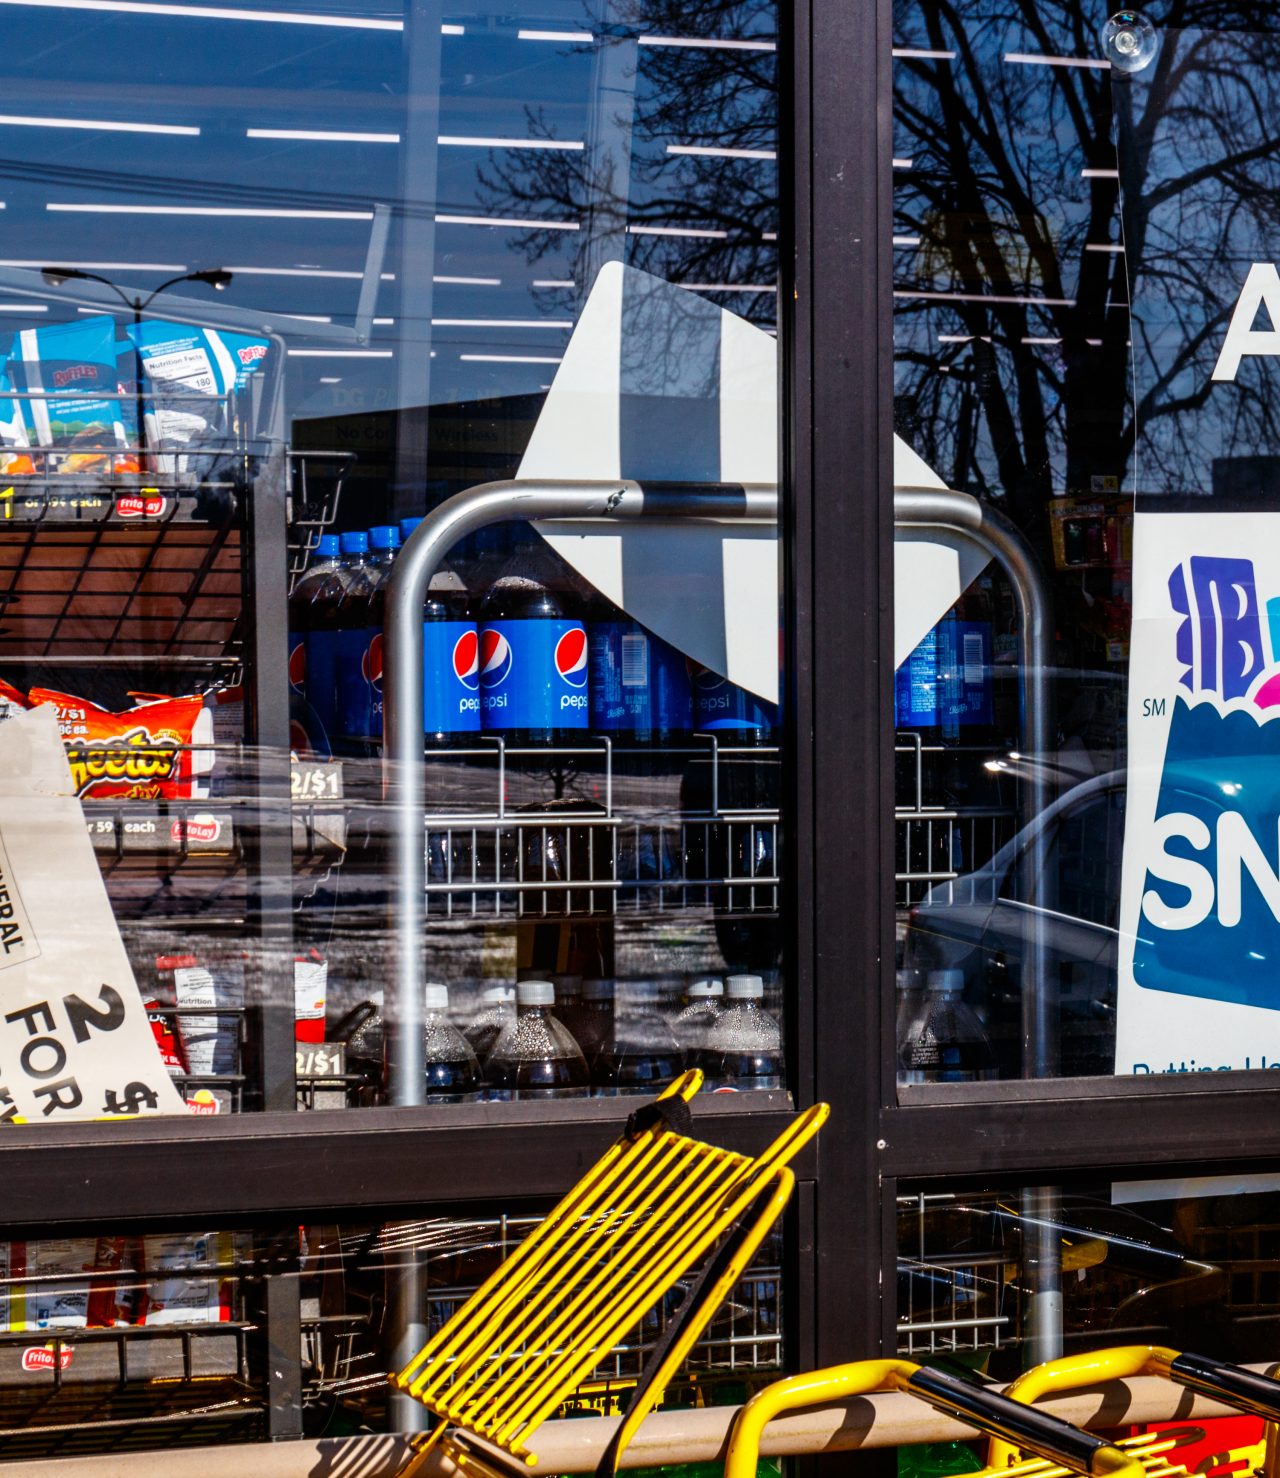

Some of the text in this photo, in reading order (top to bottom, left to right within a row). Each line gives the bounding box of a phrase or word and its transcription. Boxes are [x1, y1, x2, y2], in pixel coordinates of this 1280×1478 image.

[196, 376, 212, 388] 180
[1142, 698, 1166, 717] SM
[291, 769, 338, 795] 2/$1
[124, 821, 156, 833] each
[62, 983, 126, 1044] 2
[4, 1000, 83, 1117] FOR
[295, 1051, 341, 1076] 2/$1
